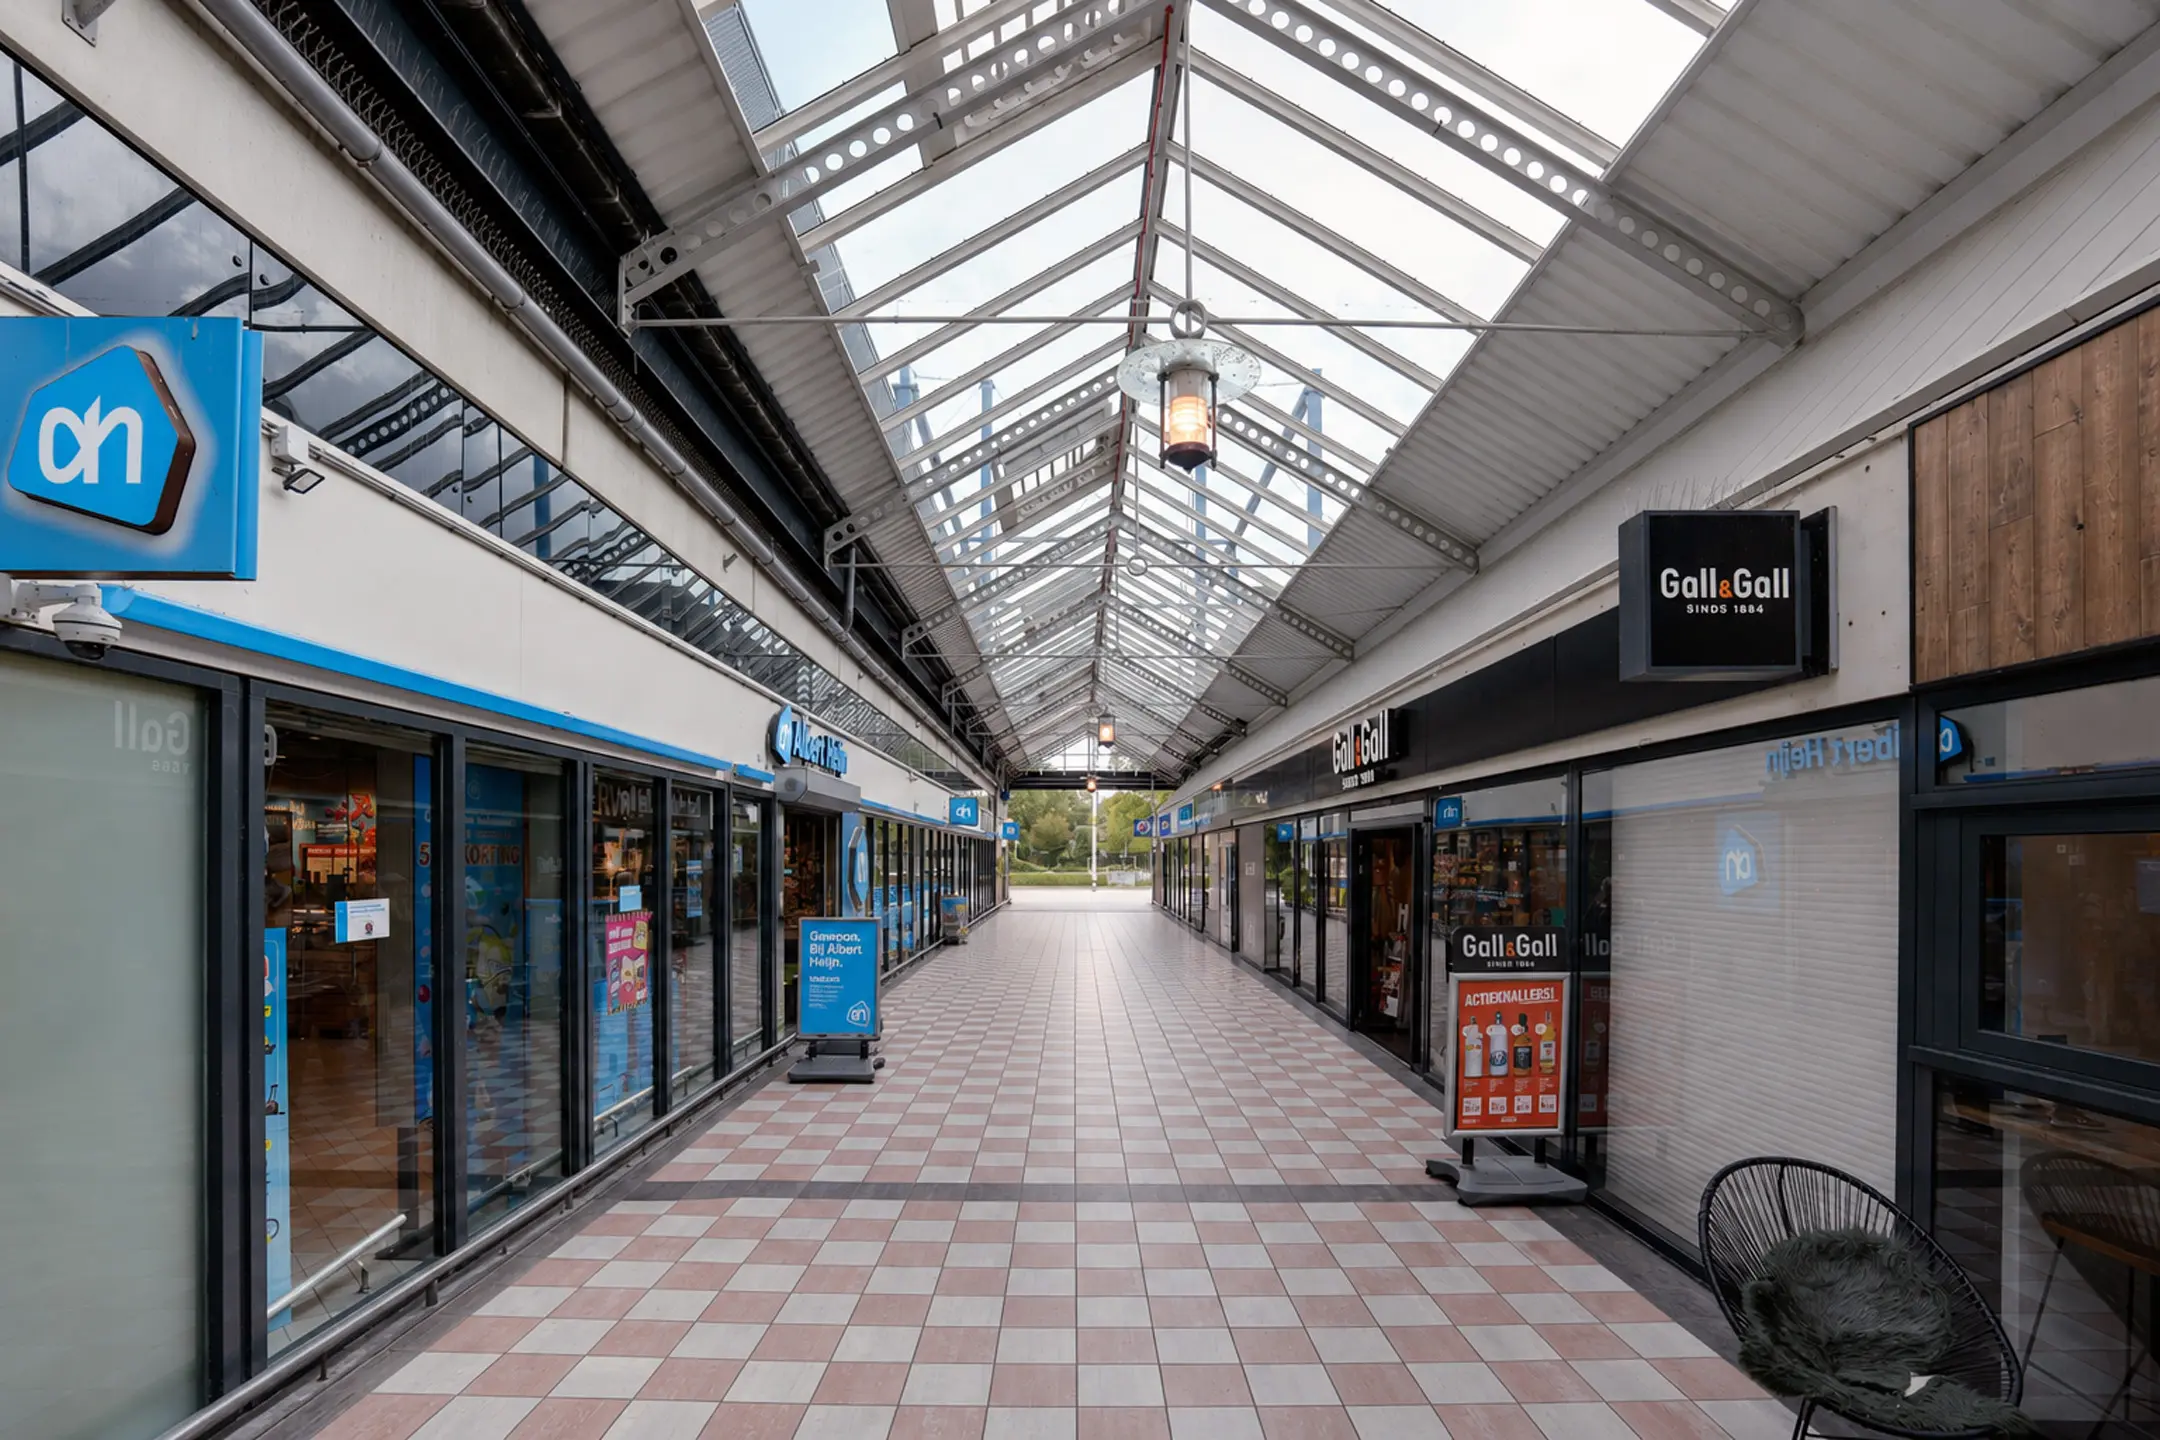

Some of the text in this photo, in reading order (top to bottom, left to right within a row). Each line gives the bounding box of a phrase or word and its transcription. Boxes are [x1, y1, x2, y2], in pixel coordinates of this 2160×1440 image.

[1660, 567, 1790, 599] Gall&Gall
[1686, 604, 1764, 614] SINDS 1884
[1332, 708, 1388, 775] Gall&Gall
[1462, 933, 1558, 957] Gall&Gall
[1464, 986, 1555, 1007] ACTIEKNALLERS!
